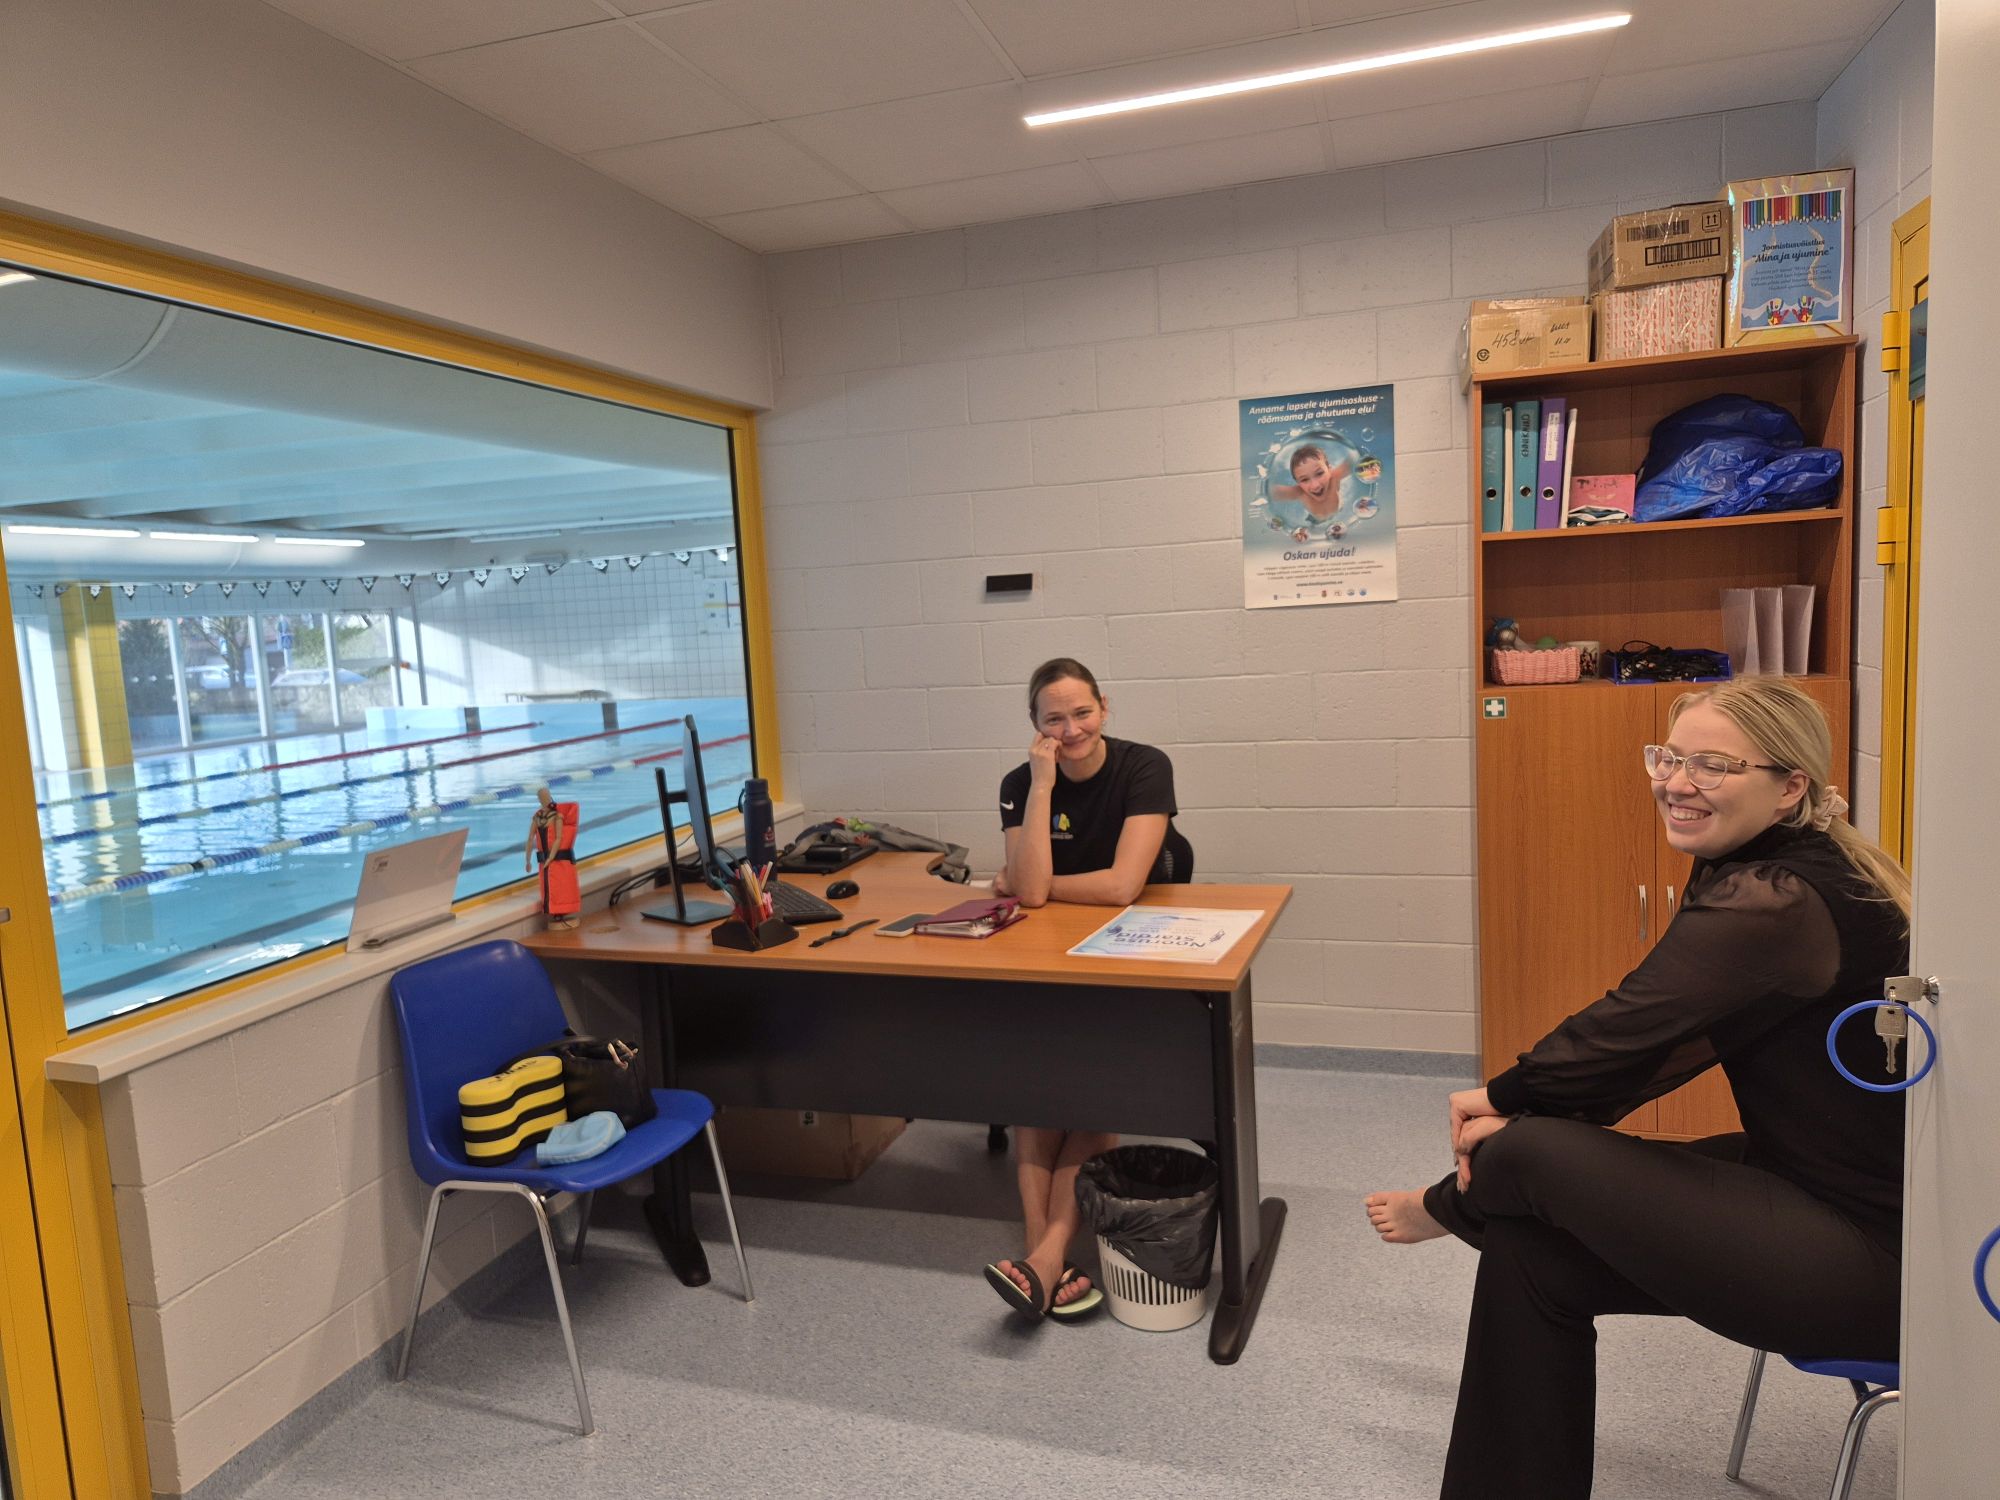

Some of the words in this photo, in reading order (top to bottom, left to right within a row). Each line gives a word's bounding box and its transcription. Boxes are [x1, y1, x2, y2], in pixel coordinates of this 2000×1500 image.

[1779, 252, 1790, 263] ja
[1249, 405, 1285, 415] Anname
[1286, 400, 1317, 411] lapsele
[1318, 394, 1379, 409] ujumisoskuse
[1304, 411, 1314, 421] ja
[1315, 407, 1356, 418] ohutuma
[1358, 404, 1376, 415] elu!
[1283, 550, 1316, 561] Oskan
[1320, 546, 1355, 561] ujuda!
[1114, 937, 1206, 948] Nooruse
